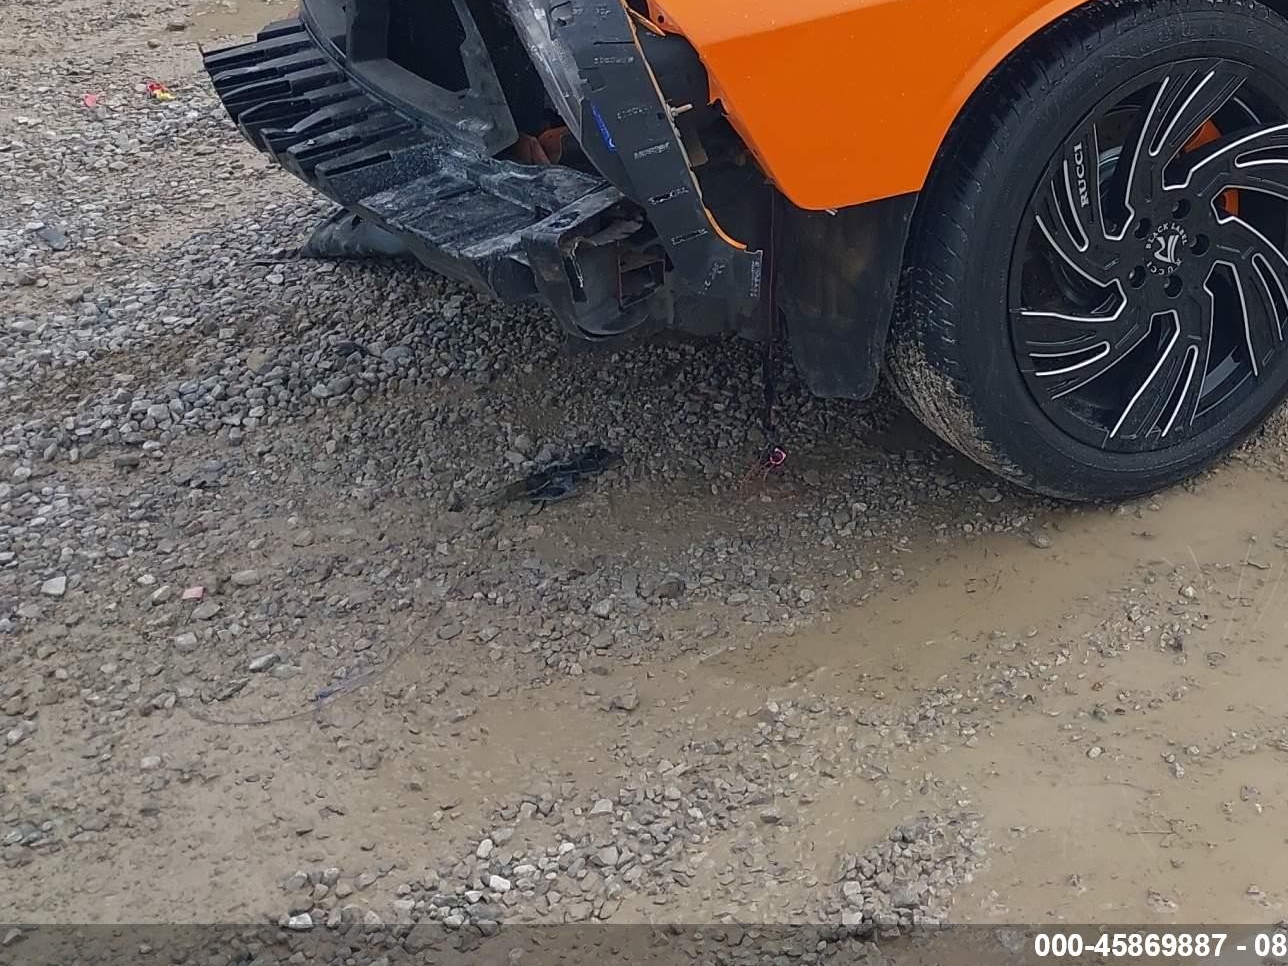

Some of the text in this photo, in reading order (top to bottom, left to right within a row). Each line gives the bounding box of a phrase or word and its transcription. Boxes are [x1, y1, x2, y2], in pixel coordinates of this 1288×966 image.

[1074, 141, 1089, 208] RUCCI
[1145, 222, 1188, 249] BLACK LABEL
